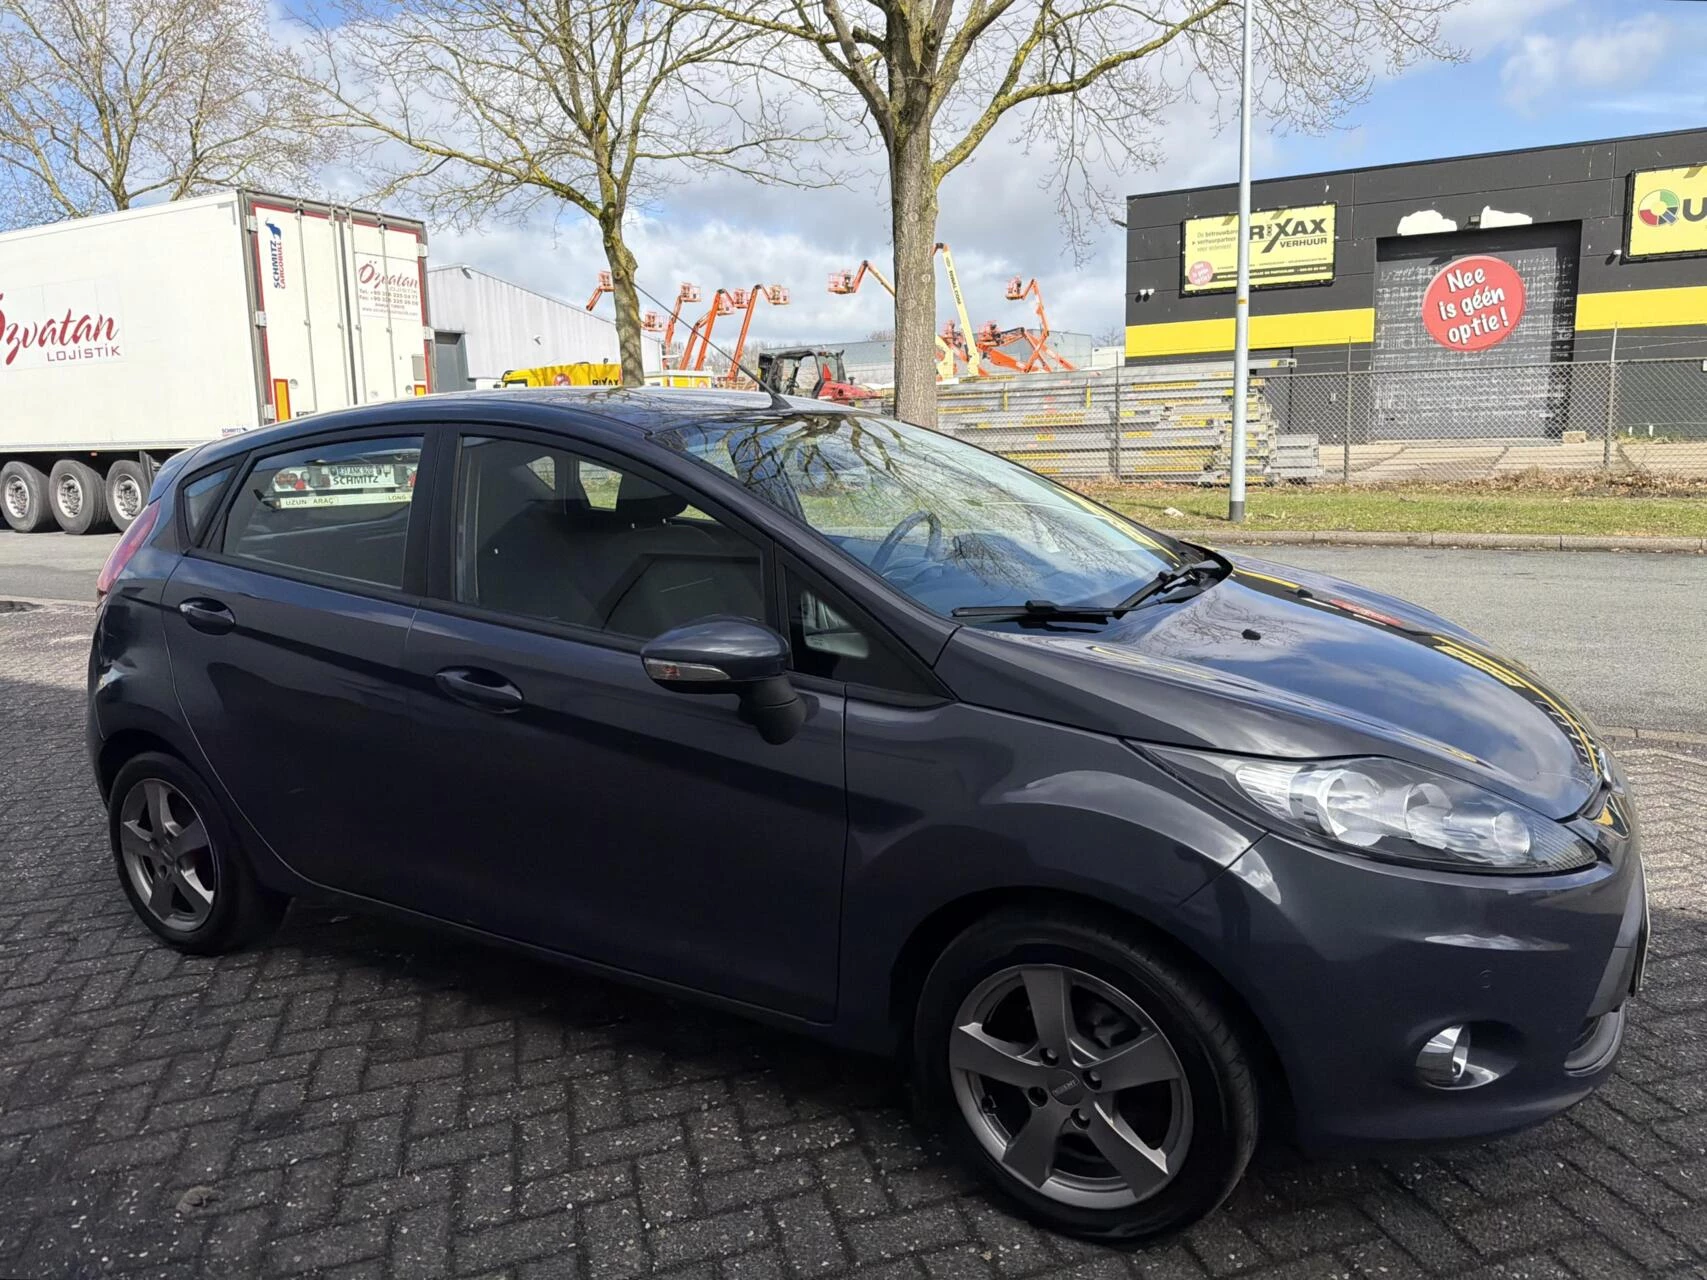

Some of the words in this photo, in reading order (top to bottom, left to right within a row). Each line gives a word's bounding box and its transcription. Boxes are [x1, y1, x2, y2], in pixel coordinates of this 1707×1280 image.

[1280, 237, 1328, 249] VERHUUR
[270, 240, 281, 289] SCHMITZ
[1445, 268, 1486, 293] Nee
[1438, 301, 1457, 321] is
[1461, 286, 1505, 316] géén
[1448, 306, 1509, 345] optie!
[333, 475, 379, 485] SCHMITZ
[285, 498, 307, 506] UZUN
[313, 497, 334, 505] ARAÇ
